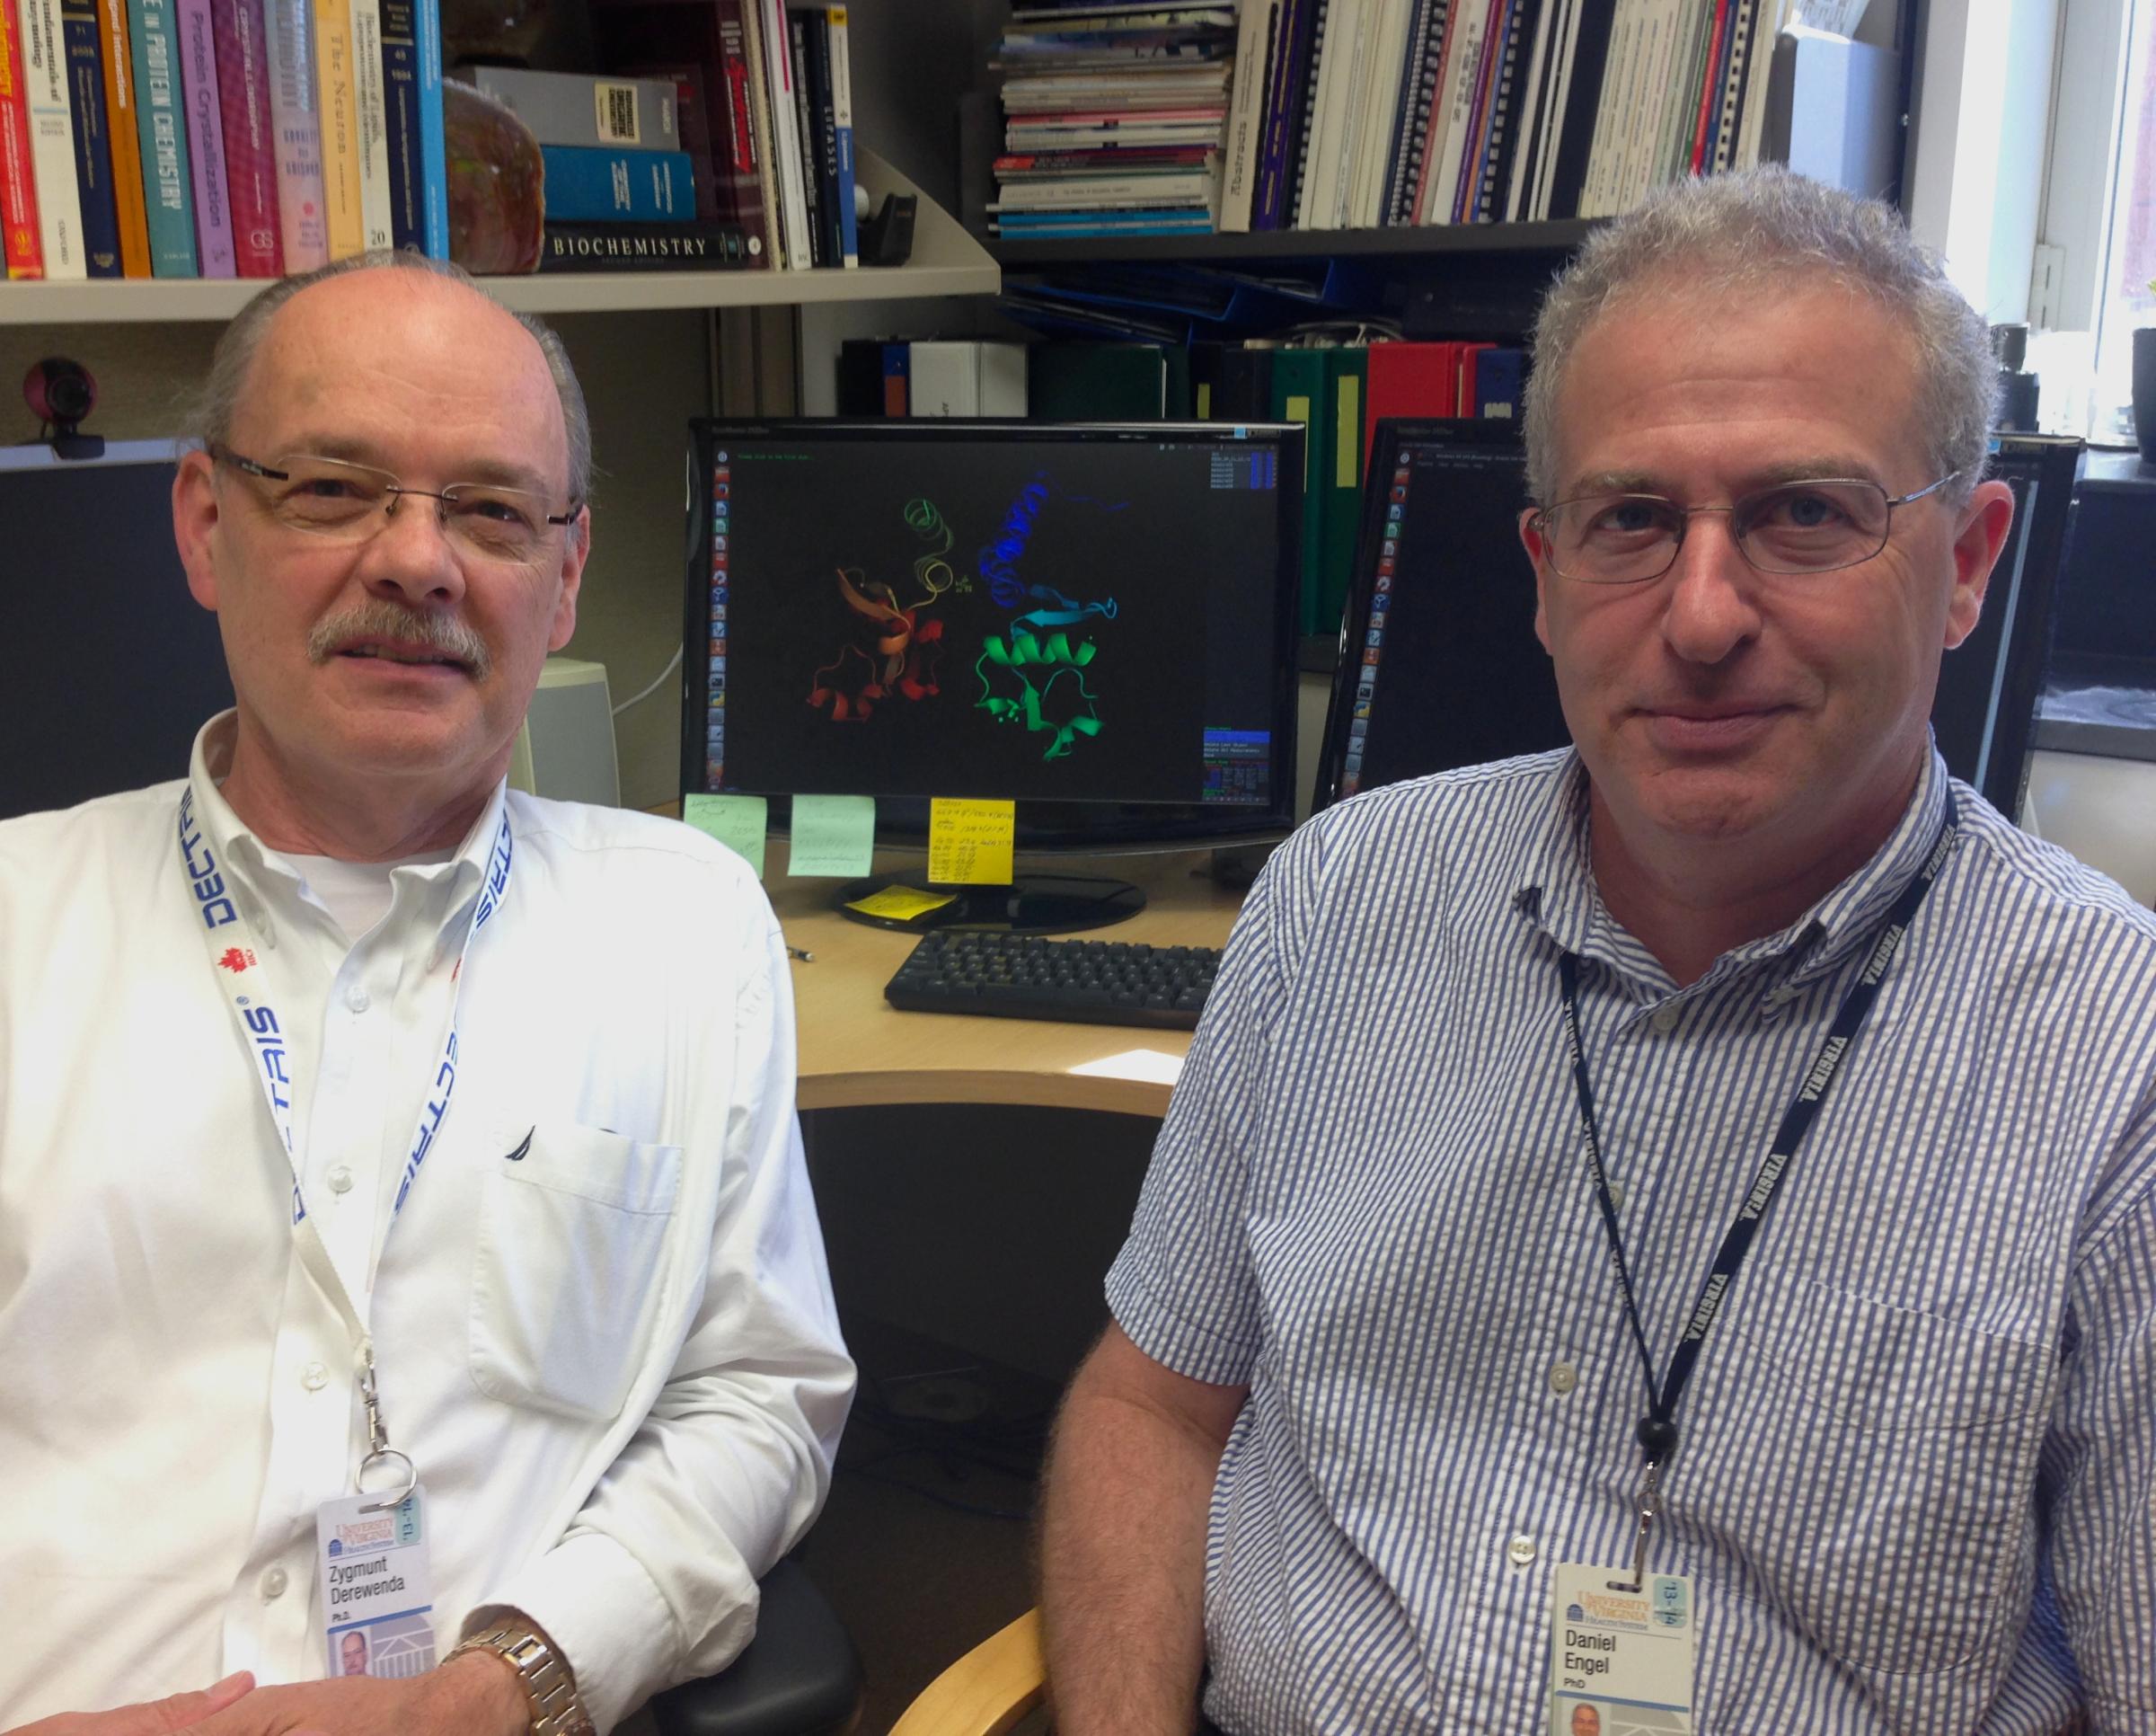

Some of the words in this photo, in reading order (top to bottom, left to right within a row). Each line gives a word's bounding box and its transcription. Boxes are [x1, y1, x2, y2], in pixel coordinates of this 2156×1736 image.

[42, 0, 59, 84] undamentals
[144, 13, 160, 29] IN
[190, 11, 208, 84] Protein
[330, 33, 346, 73] The
[146, 33, 172, 106] PROTEIN
[333, 79, 349, 155] Neuron
[822, 105, 837, 177] LIPASES
[153, 111, 182, 210] CHEMISTRY
[197, 86, 223, 228] Crystallization
[1231, 121, 1248, 197] Abstracts
[371, 229, 386, 246] 20
[553, 235, 706, 256] BIOCHEMISTRY
[1862, 924, 1904, 987] VIRGINIA
[1798, 1035, 1849, 1103] VIRGINIA
[394, 1031, 459, 1215] ECTRIS
[1739, 1153, 1789, 1222] VIRGINIA
[1683, 1272, 1729, 1343] VIRGINIA
[329, 1556, 388, 1584] Zygmunt
[331, 1576, 405, 1605] Derewenda
[1564, 1652, 1610, 1676] Engel
[1565, 1629, 1616, 1652] Daniel
[1563, 1677, 1586, 1689] PhD
